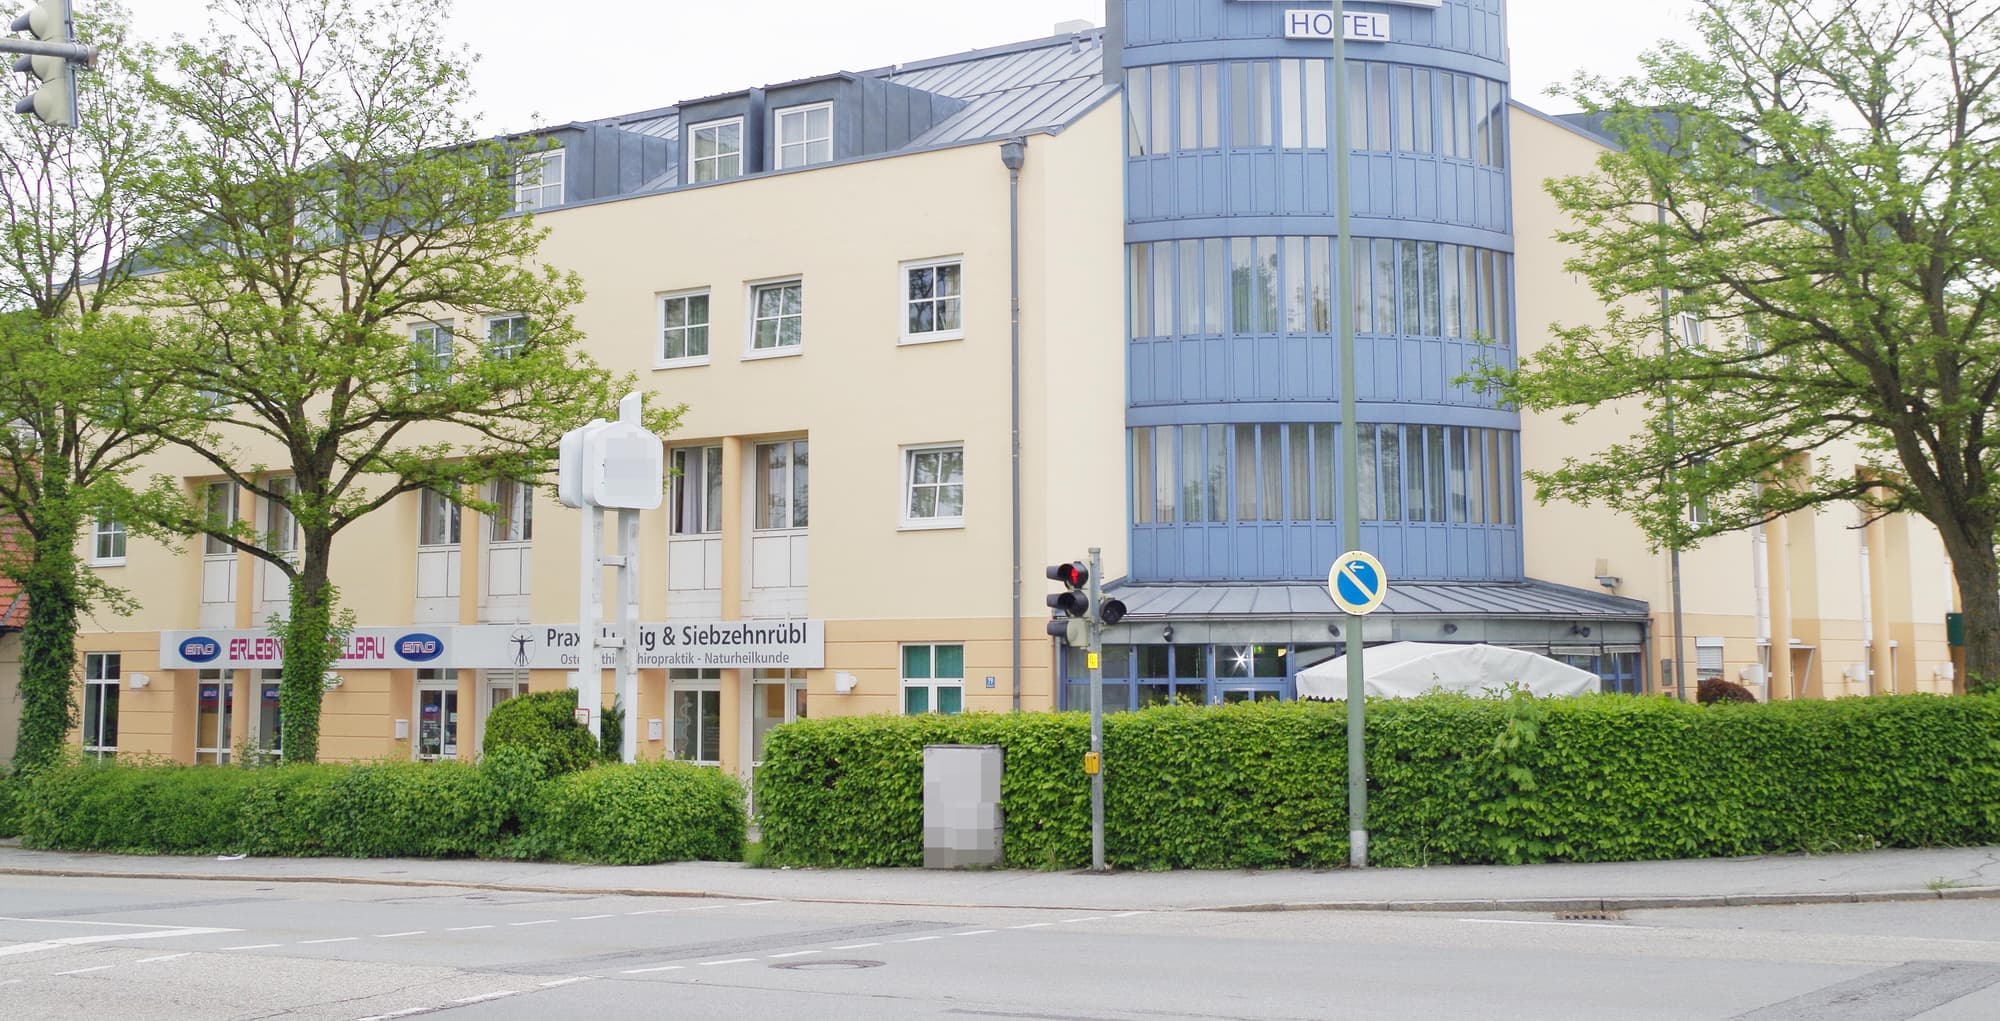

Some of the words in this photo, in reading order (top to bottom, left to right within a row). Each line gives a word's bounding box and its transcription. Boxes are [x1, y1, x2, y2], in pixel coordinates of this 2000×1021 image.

[1292, 13, 1385, 38] HOTEL
[546, 627, 581, 648] Prax
[662, 626, 675, 646] &
[682, 622, 807, 646] Siebzehnrübl
[229, 636, 286, 661] ERLEBN
[637, 651, 695, 667] hiropraktik
[704, 651, 790, 665] Naturheilkunde
